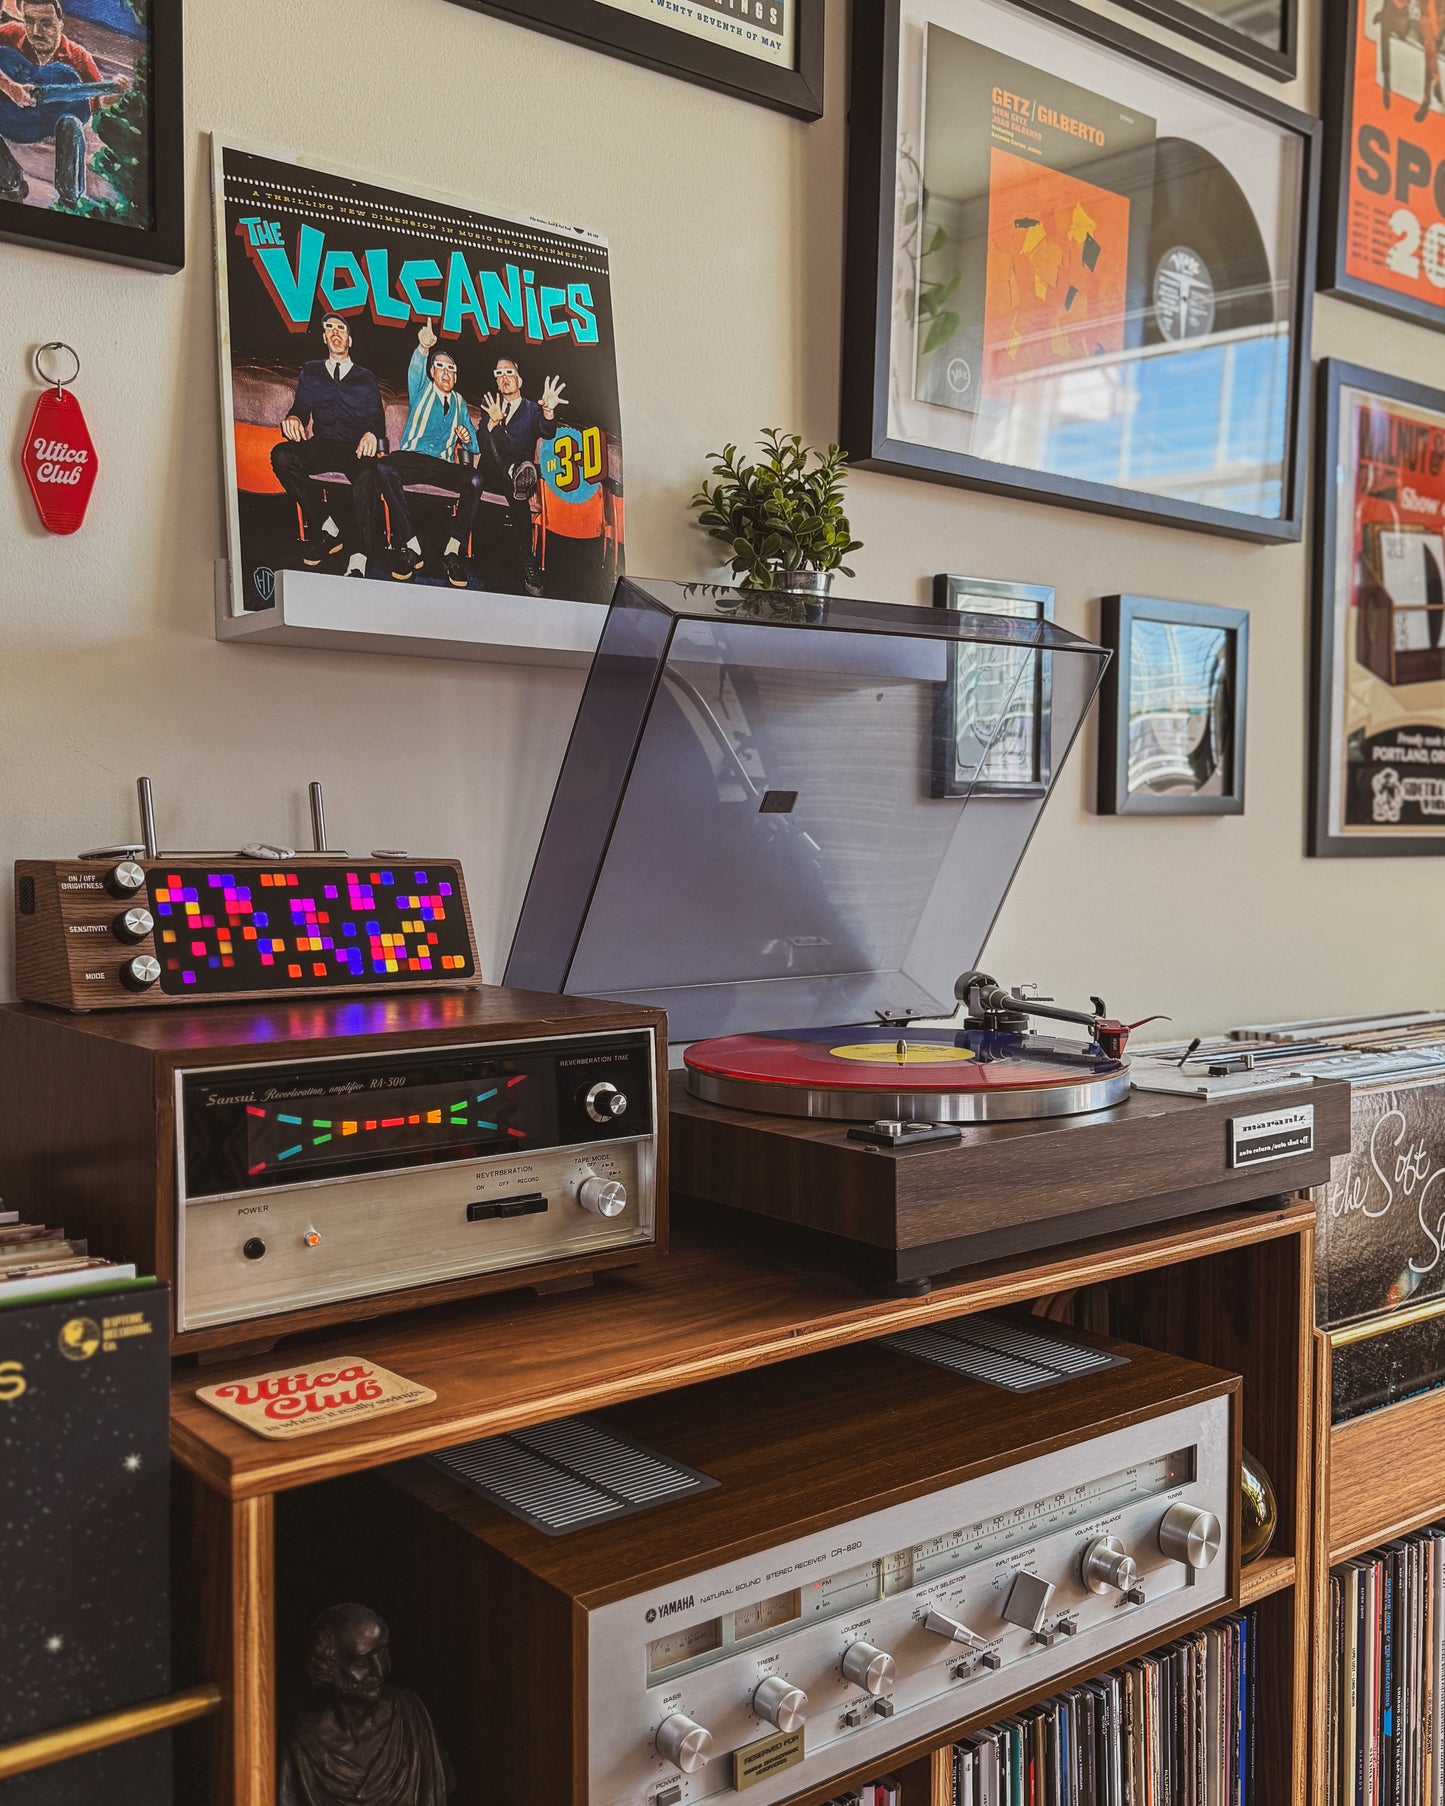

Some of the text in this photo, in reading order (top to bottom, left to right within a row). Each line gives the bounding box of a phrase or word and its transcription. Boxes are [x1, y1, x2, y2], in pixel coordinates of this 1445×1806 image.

[713, 0, 778, 26] INGS
[696, 12, 743, 36] SEVENTH
[746, 32, 758, 41] OF
[762, 37, 782, 50] MAY
[991, 86, 1105, 148] GETZ GILBERTO
[1010, 112, 1027, 126] GETZ
[238, 217, 285, 246] THE
[265, 192, 334, 211] THRILLING
[340, 207, 366, 217] NEW
[372, 214, 436, 231] DIMENSION
[459, 230, 493, 242] MUSIC
[497, 238, 588, 261] ENTERTAINMENT!
[34, 438, 88, 464] Utica
[547, 426, 602, 487] IN 3-D
[36, 462, 82, 485] Club
[560, 1056, 612, 1067] REVERBERATION
[206, 1092, 257, 1106] Sansui
[328, 1081, 364, 1095] amplifier
[370, 1076, 406, 1089] RA-500
[476, 1166, 533, 1179] REVERBERATION
[1330, 1110, 1430, 1218] the Soft
[238, 1205, 269, 1215] POWER
[215, 1366, 374, 1405] Utica
[264, 1380, 383, 1420] Club
[280, 1414, 324, 1428] where
[339, 1402, 376, 1415] really
[1168, 1491, 1182, 1499] TUNING
[894, 1552, 905, 1561] 90
[933, 1538, 943, 1546] 94
[953, 1531, 962, 1539] 96
[973, 1523, 982, 1531] 98
[1014, 1508, 1024, 1517] 102
[1034, 1501, 1045, 1509] 104
[1054, 1494, 1065, 1502] 106
[1075, 1486, 1086, 1494] 108
[1075, 1514, 1122, 1536] VOLUME BALANCE
[996, 1548, 1035, 1567] INPUT SELECTOR
[658, 1595, 695, 1618] YAMAHA
[700, 1589, 734, 1604] NATURAL
[735, 1578, 761, 1592] SOUND
[766, 1566, 793, 1580] STEREO
[795, 1554, 826, 1571] RECEIVER
[928, 1585, 939, 1593] OUT
[940, 1575, 967, 1588] SELECTOR
[1056, 1609, 1071, 1618] MODE
[841, 1619, 871, 1634] LOUDNESS
[988, 1638, 1003, 1647] FILTER
[757, 1654, 780, 1667] TREBLE
[959, 1651, 974, 1663] FILTER
[663, 1692, 681, 1704] BASS
[744, 1735, 799, 1764] RESERVED FOR
[655, 1775, 681, 1790] POWER
